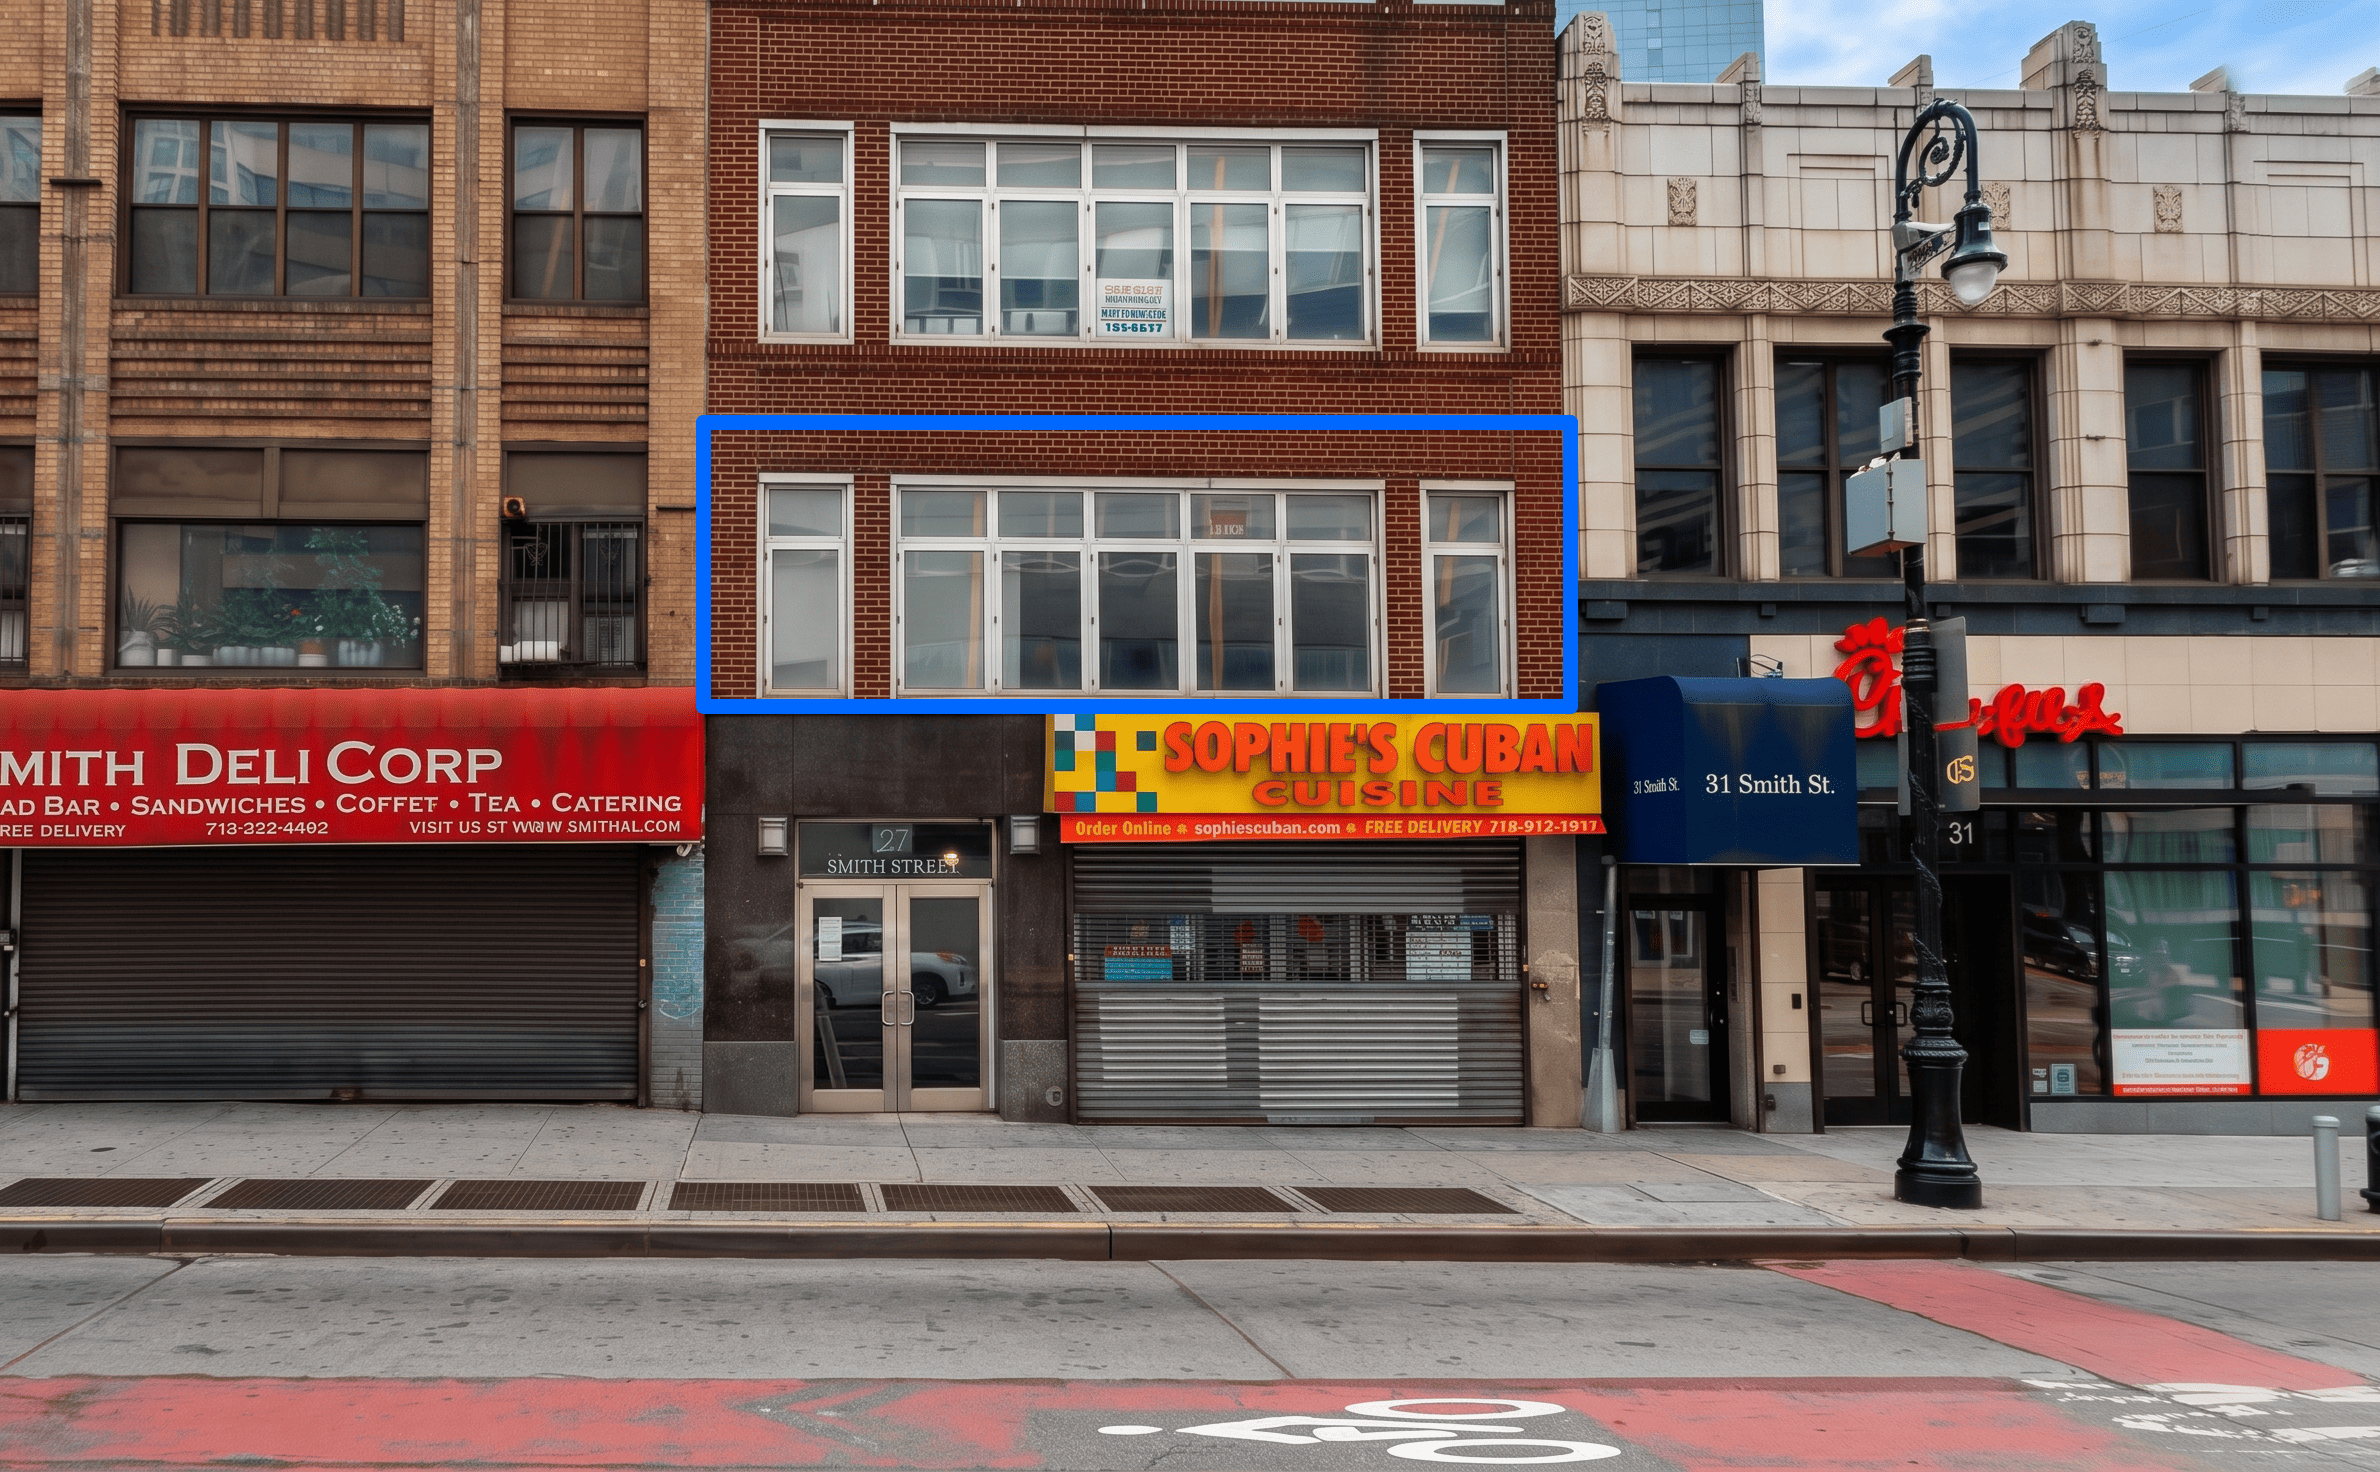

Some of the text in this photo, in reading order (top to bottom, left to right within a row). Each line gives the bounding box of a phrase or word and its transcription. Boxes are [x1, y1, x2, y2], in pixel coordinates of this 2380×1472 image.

[1164, 721, 1594, 775] SOPHIE'S CUBAN
[0, 741, 502, 786] MITH DELI CORP
[1252, 780, 1504, 807] CUISINE
[1633, 777, 1680, 794] 31 Smith St.
[1706, 773, 1835, 794] 31 Smith St.
[44, 796, 100, 816] BAR
[131, 796, 306, 816] SANDWICHES
[468, 792, 521, 813] TEA
[551, 792, 682, 813] CATERING
[40, 824, 127, 838] DELIVERY
[409, 821, 453, 834] VISIT
[459, 821, 481, 834] US
[1076, 821, 1117, 836] Order
[1122, 820, 1171, 836] Online
[1195, 820, 1340, 838] sophiescuban.com
[1365, 820, 1403, 834] FREE
[1407, 820, 1483, 834] DELIVERY
[1949, 822, 1973, 844] 31
[877, 829, 909, 852] 27
[827, 859, 886, 874] SMITH
